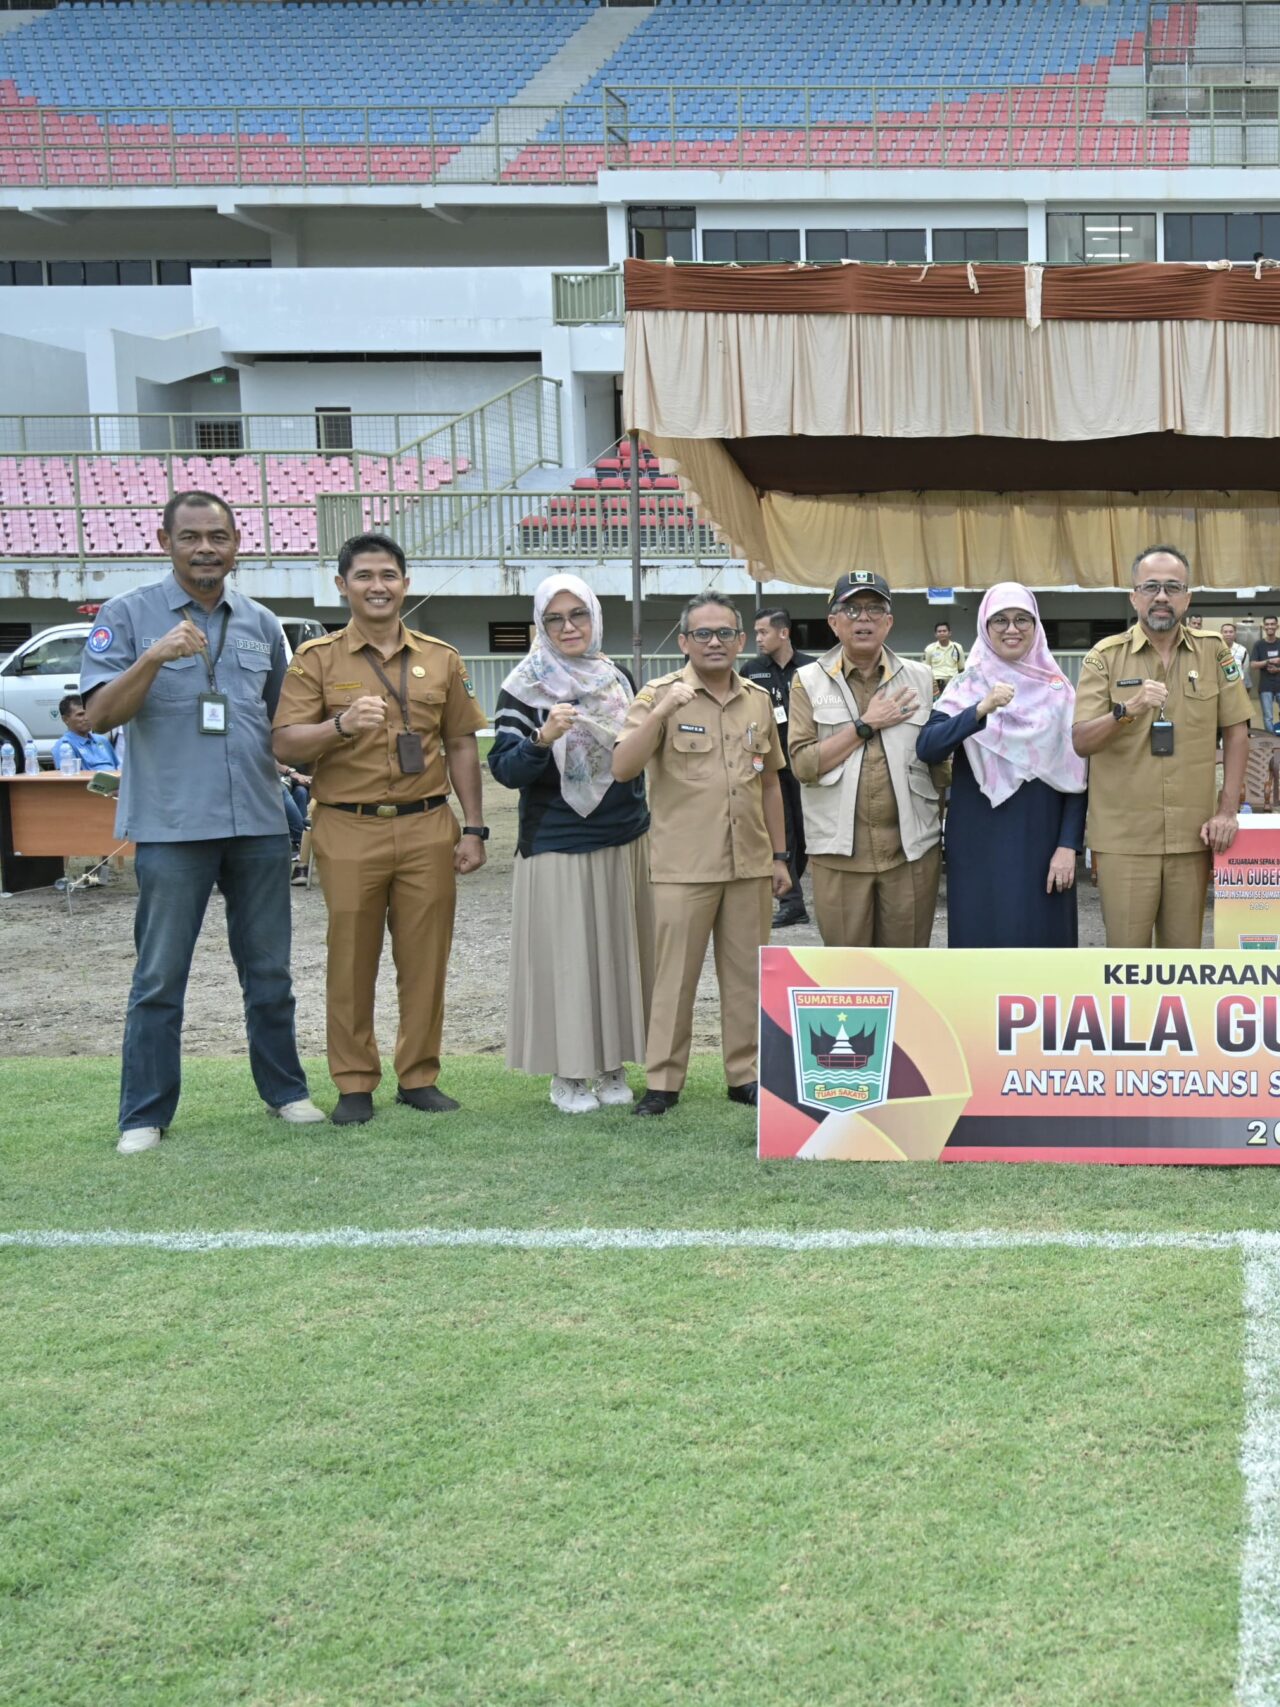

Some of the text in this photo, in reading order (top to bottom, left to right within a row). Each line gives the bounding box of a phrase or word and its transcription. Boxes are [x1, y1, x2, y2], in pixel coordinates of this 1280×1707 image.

[797, 995, 890, 1005] SUMATERA BARAT
[996, 995, 1198, 1057] PIALA
[1001, 1069, 1106, 1097] ANTAR
[1116, 1070, 1260, 1098] INSTANSI
[816, 1089, 868, 1099] TUAH SAKATO
